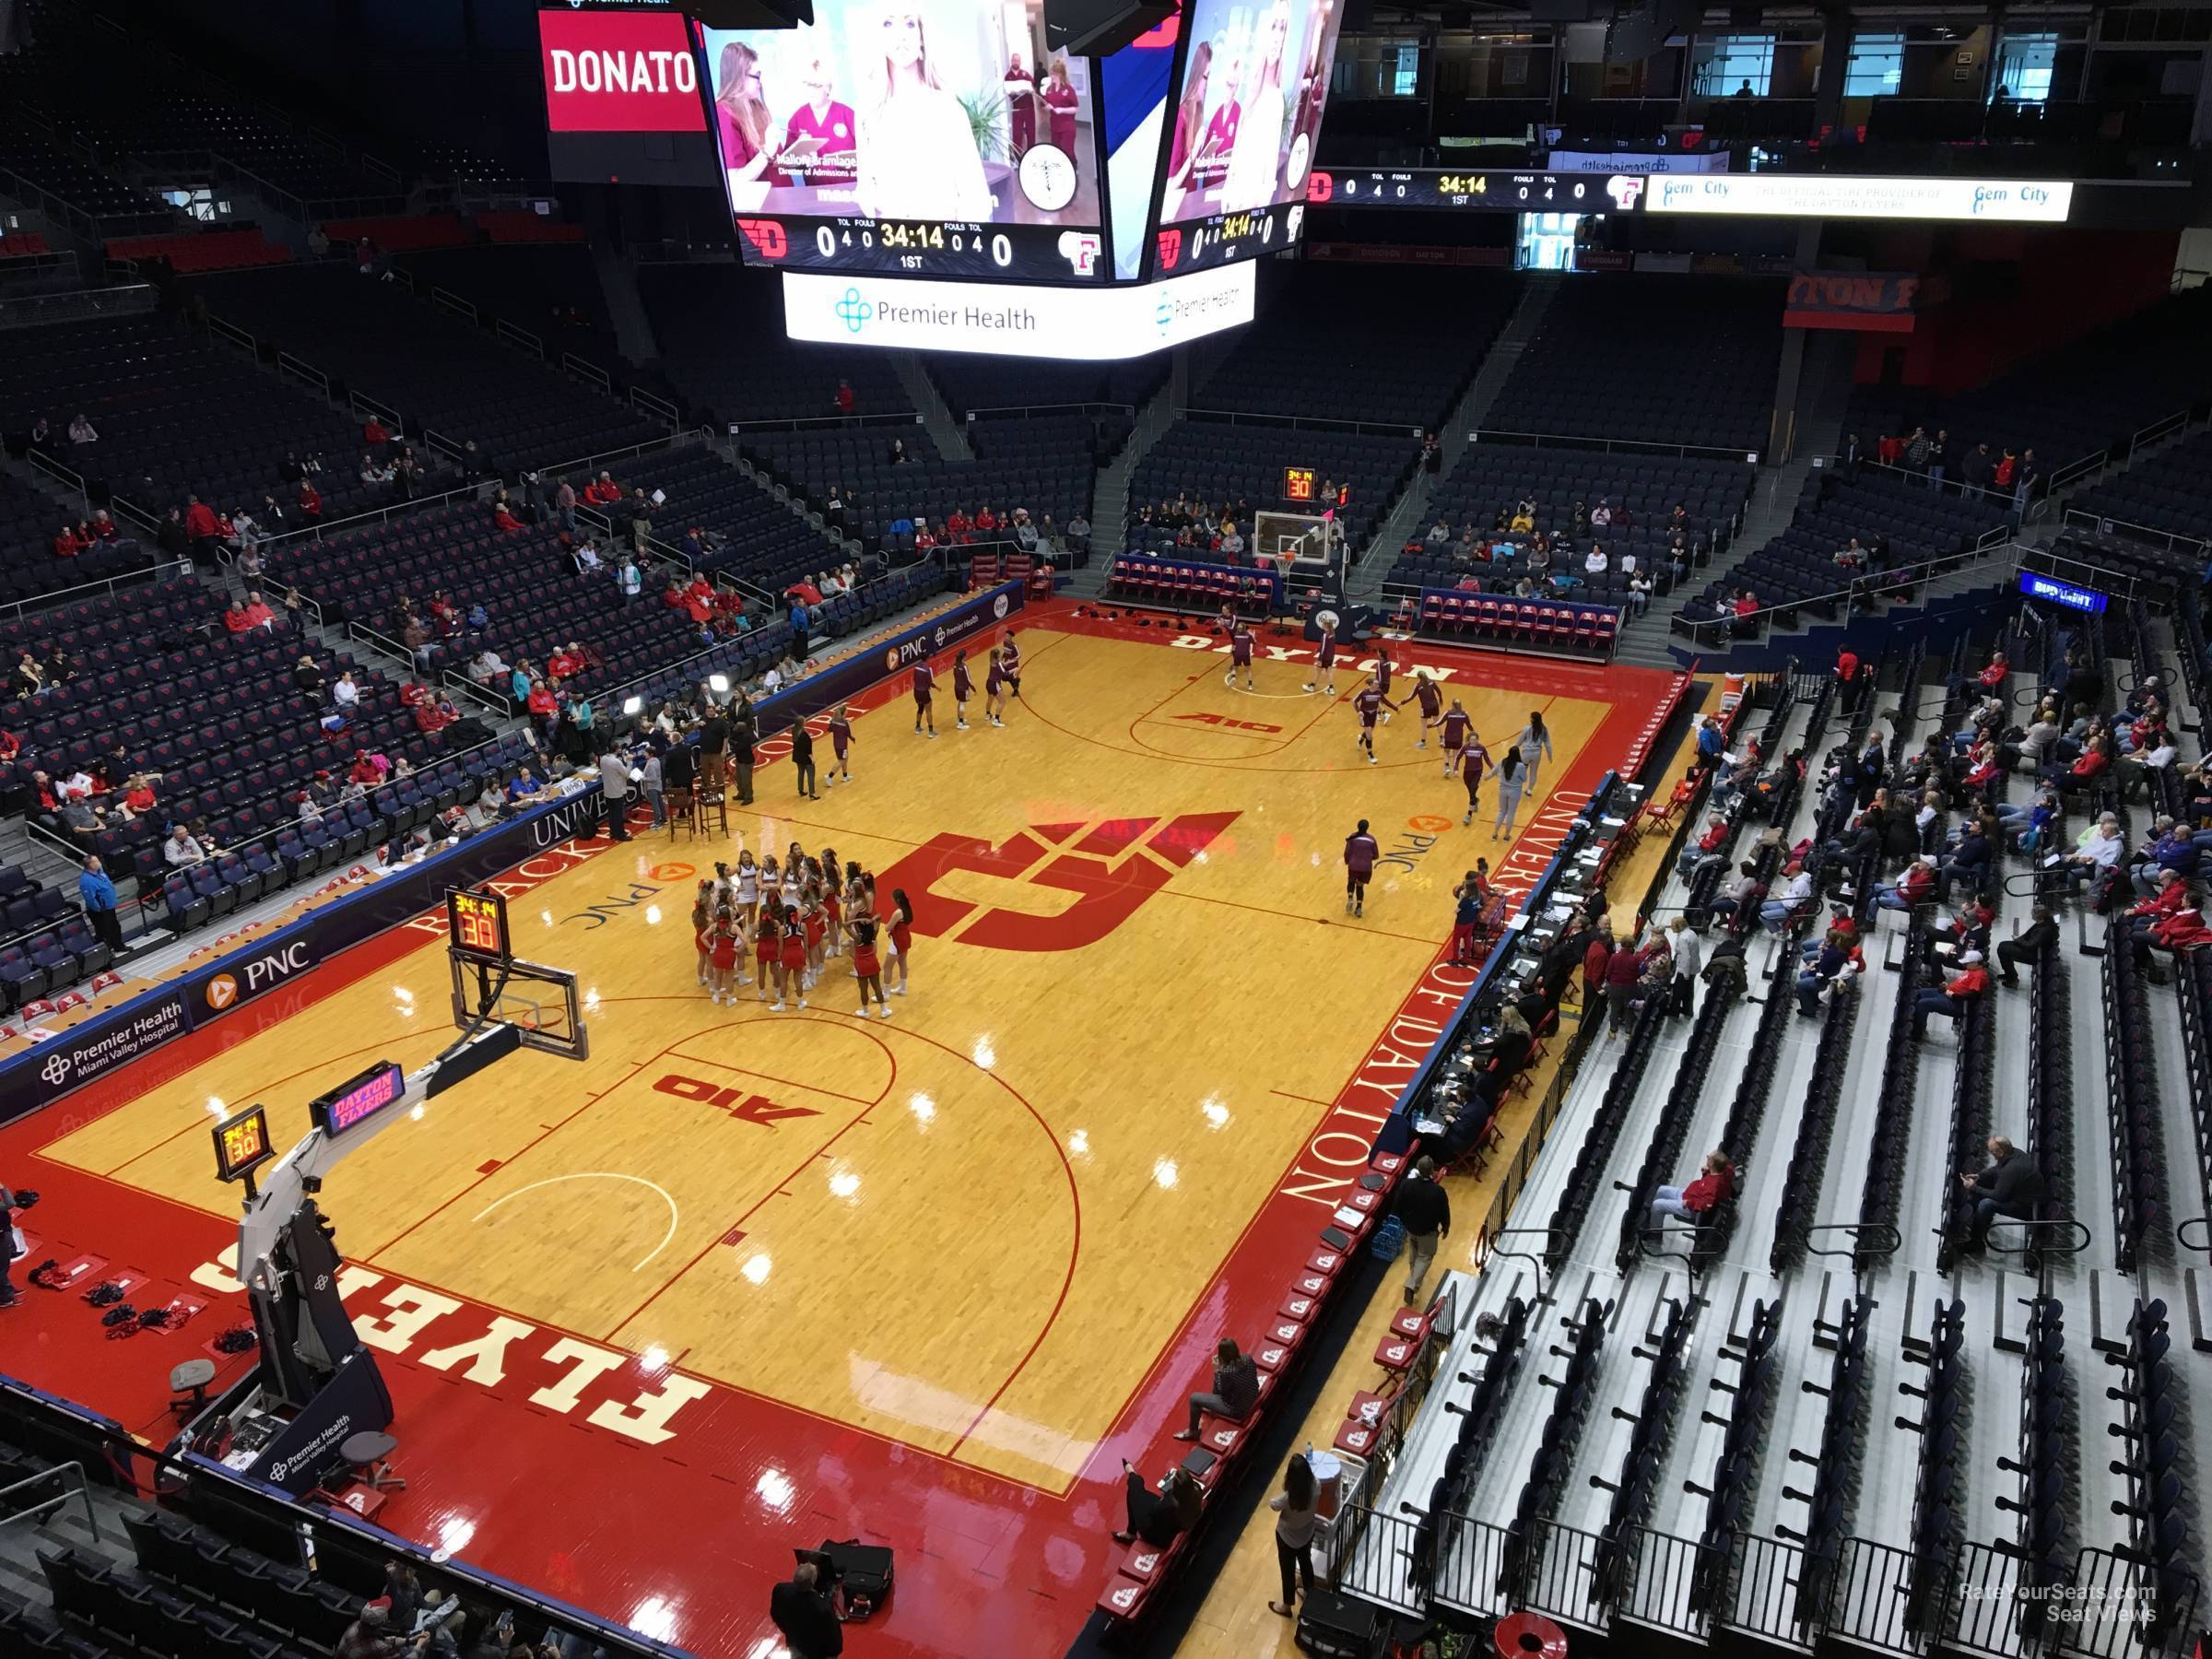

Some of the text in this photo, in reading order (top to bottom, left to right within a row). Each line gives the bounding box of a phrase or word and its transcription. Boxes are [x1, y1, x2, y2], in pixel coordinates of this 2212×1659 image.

[551, 49, 696, 93] DONATO
[813, 169, 849, 177] Admissions
[1440, 176, 1486, 194] 34:14
[1346, 179, 1405, 197] 0 4 0
[1453, 195, 1468, 205] 1ST
[1520, 183, 1585, 200] 0 4 0
[1665, 181, 1730, 196] Gem City
[1974, 186, 2050, 206] Gem City
[854, 218, 876, 228] FOULS
[880, 223, 945, 249] 34:14
[944, 223, 982, 232] FOULS TOL
[1222, 214, 1251, 240] 34:14
[1262, 215, 1273, 243] 0
[817, 226, 836, 257] 0
[841, 230, 872, 248] 4 0
[951, 234, 982, 252] 0 4
[992, 234, 1012, 266] 0
[1192, 229, 1204, 260] 0
[1225, 245, 1236, 259] 1ST
[900, 255, 923, 268] 1ST
[877, 301, 1035, 330] Premier Health
[1288, 470, 1312, 481] 34:14
[1290, 479, 1309, 497] 30
[900, 636, 927, 664] PNC
[565, 779, 583, 794] WHIO
[1373, 833, 1439, 874] PNC
[454, 895, 497, 919] 34:14
[559, 883, 665, 930] PNC
[463, 914, 494, 949] 30
[243, 941, 310, 991] PNC
[73, 1003, 182, 1065] Premier Health
[76, 1019, 179, 1077] Miami Valley Hospital
[334, 1071, 393, 1117] DAYTON
[337, 1086, 393, 1129] FLYERS
[1280, 1012, 1444, 1210] DAYTON
[233, 1135, 256, 1163] 30
[287, 1415, 350, 1467] Premier Health
[291, 1425, 349, 1475] Miami Valley Hospital
